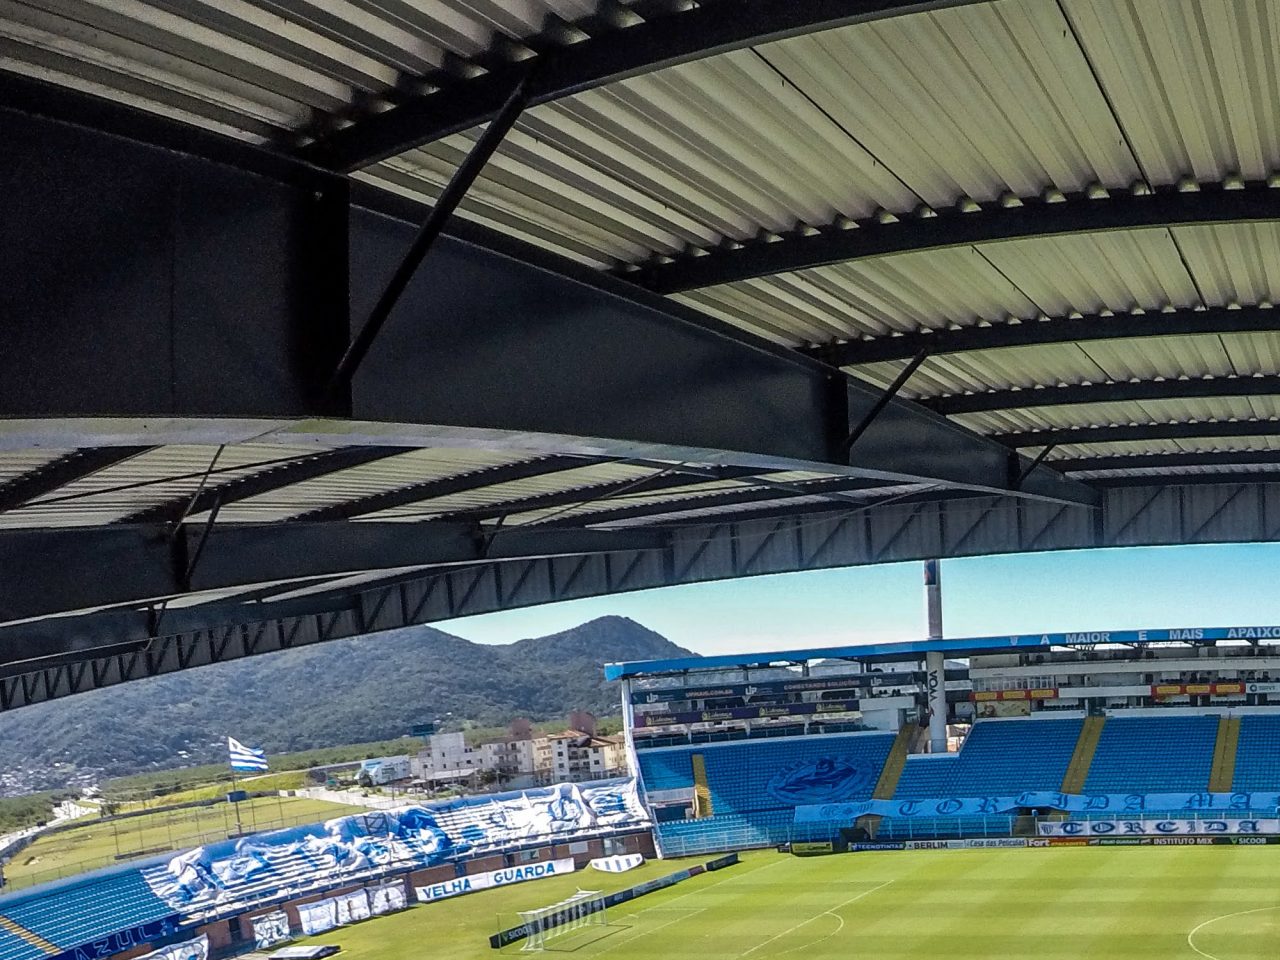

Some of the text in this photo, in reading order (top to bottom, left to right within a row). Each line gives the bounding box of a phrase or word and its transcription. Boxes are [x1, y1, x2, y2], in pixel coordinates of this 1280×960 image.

[1040, 635, 1050, 645] A
[1065, 632, 1110, 643] MAIOR
[1138, 630, 1148, 641] E
[1169, 629, 1204, 640] MAIS
[899, 791, 1145, 816] TORCIDA
[1061, 820, 1260, 835] TORCIDA
[914, 841, 948, 849] BERLIM
[970, 839, 984, 847] Casa
[986, 839, 997, 847] das
[1028, 839, 1050, 847] Fort
[1153, 837, 1214, 845] INSTITUTO MIX
[423, 862, 555, 899] VELHA GUARDA
